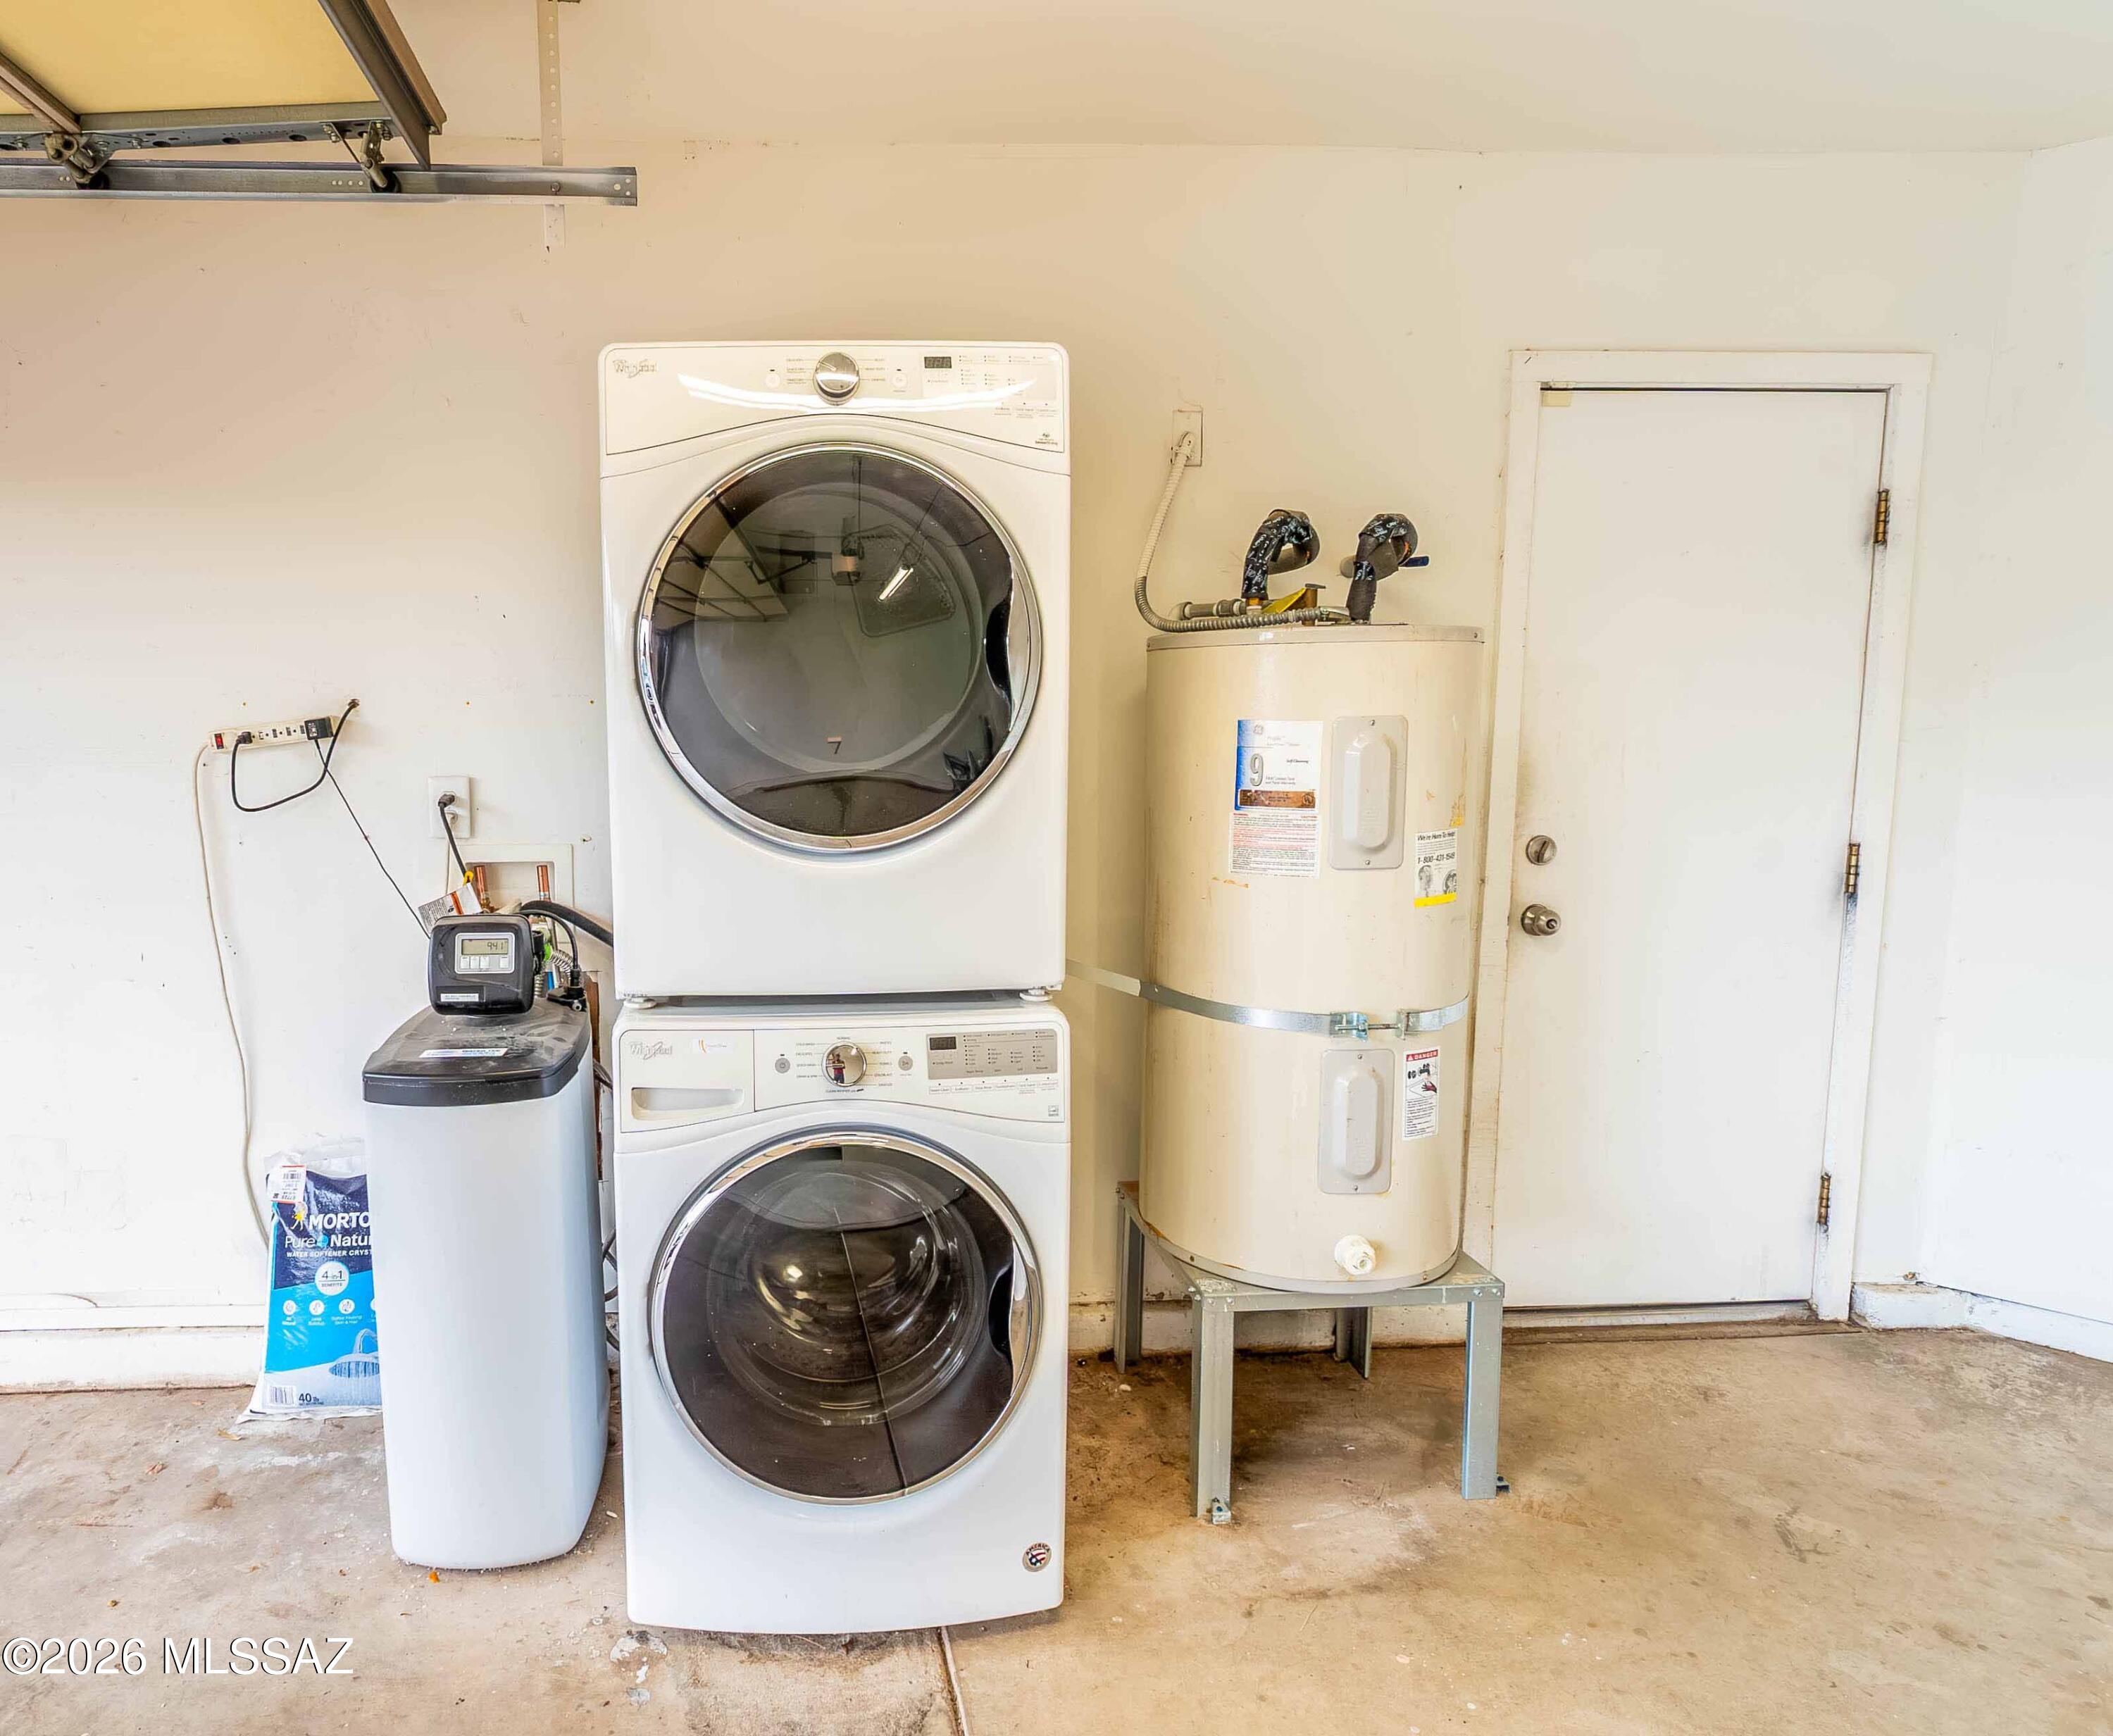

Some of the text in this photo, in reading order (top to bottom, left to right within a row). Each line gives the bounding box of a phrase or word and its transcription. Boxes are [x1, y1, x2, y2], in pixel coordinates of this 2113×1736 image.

[1250, 753, 1264, 787] 9
[285, 1235, 316, 1249] Pure
[299, 1393, 311, 1402] 40
